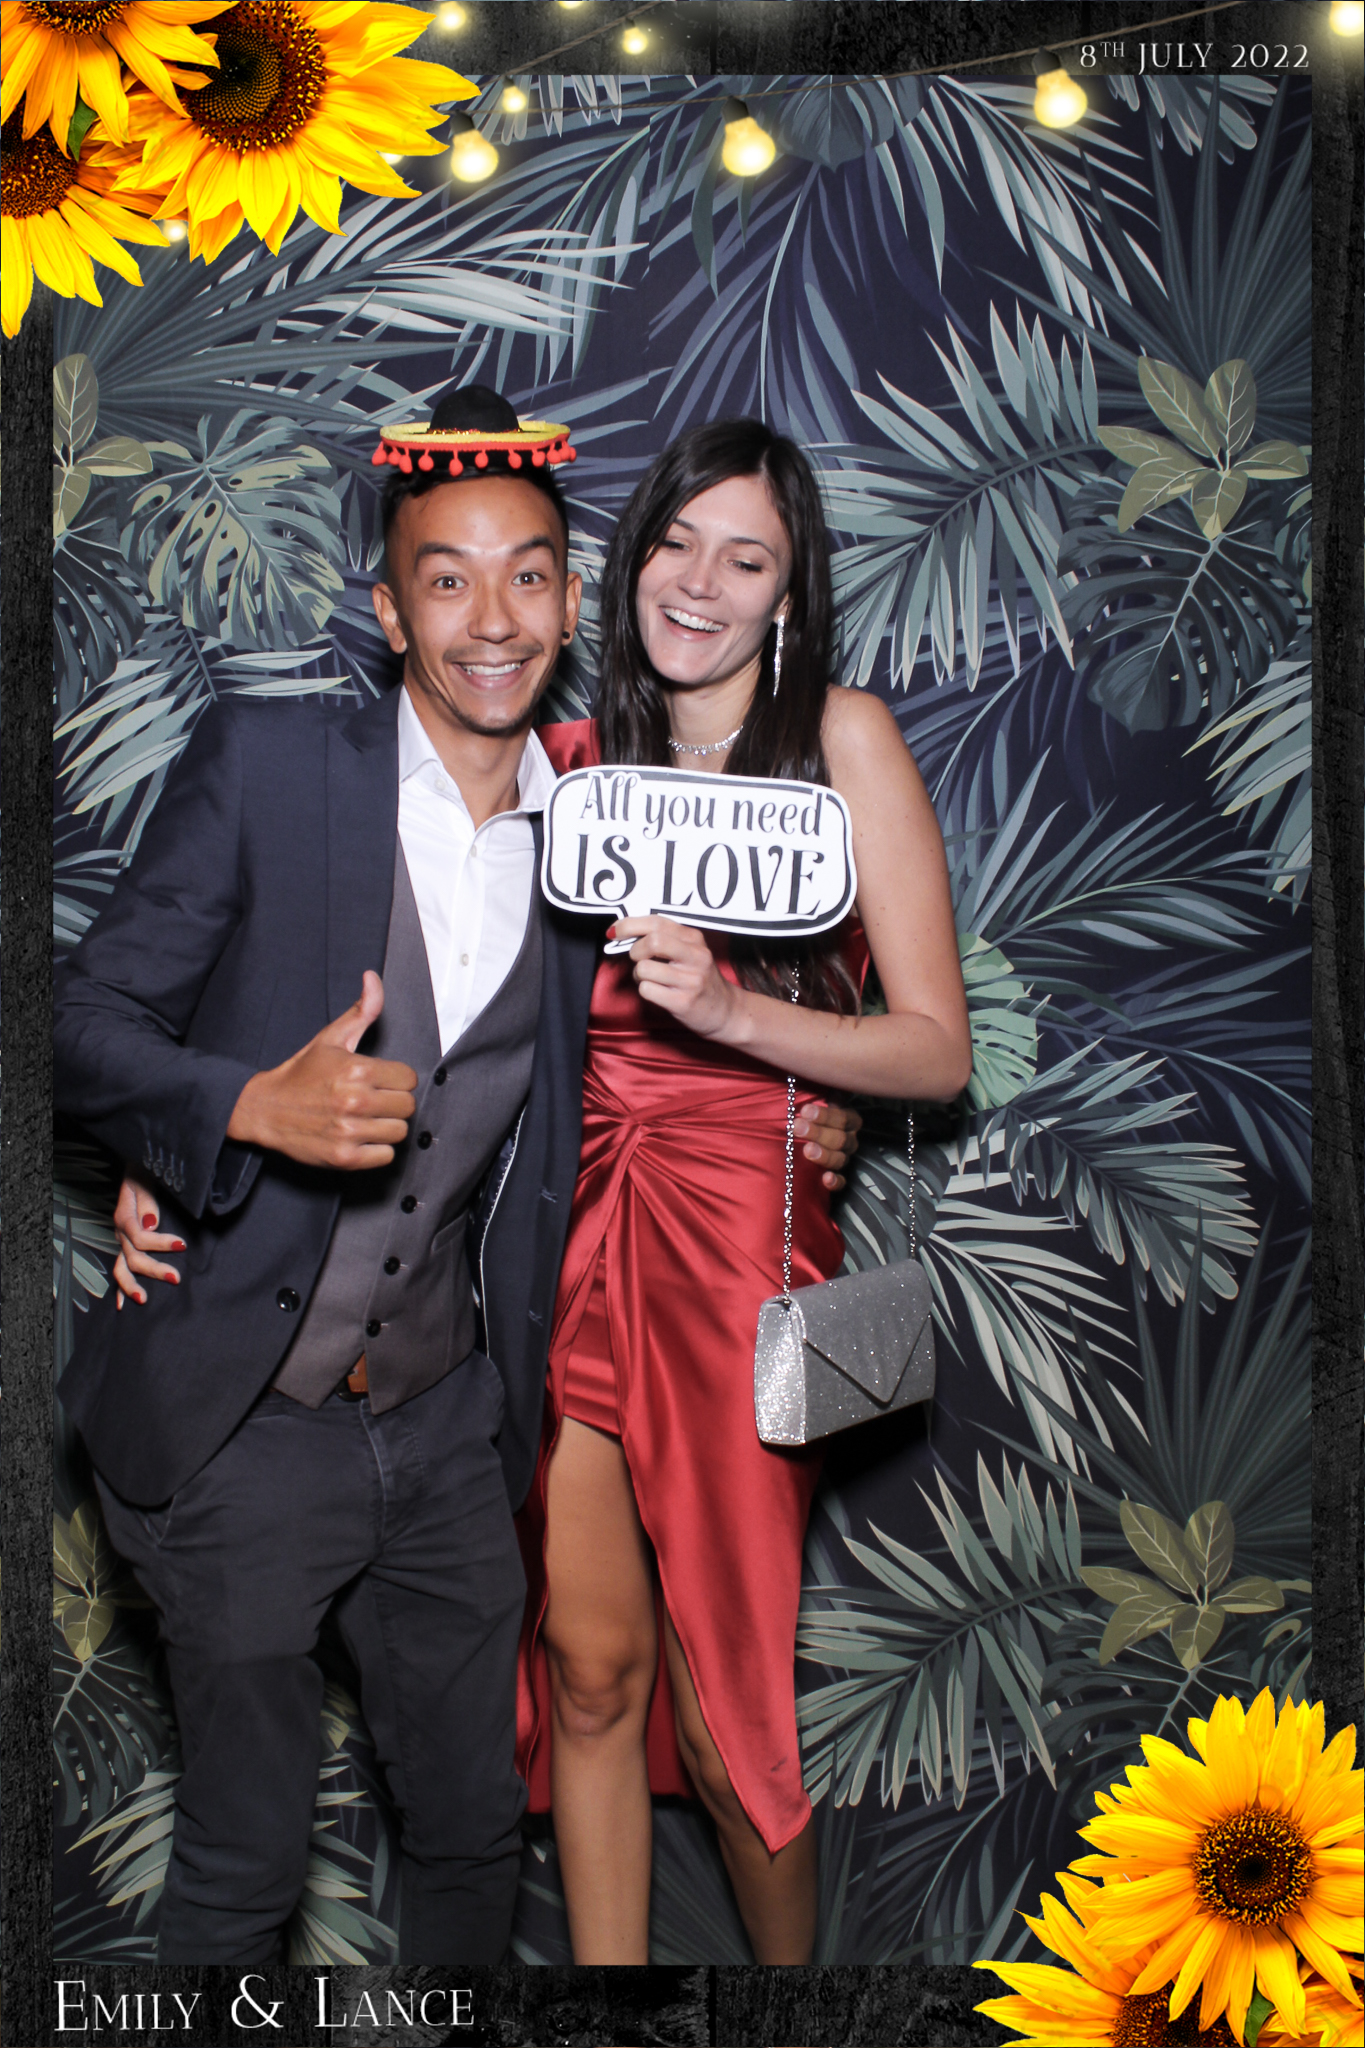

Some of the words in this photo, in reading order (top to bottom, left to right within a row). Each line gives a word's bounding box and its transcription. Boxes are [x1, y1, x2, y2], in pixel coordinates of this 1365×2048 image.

[579, 774, 638, 822] All
[642, 793, 716, 840] you
[732, 792, 824, 837] need
[573, 833, 637, 902] IS
[660, 839, 826, 917] LOVE
